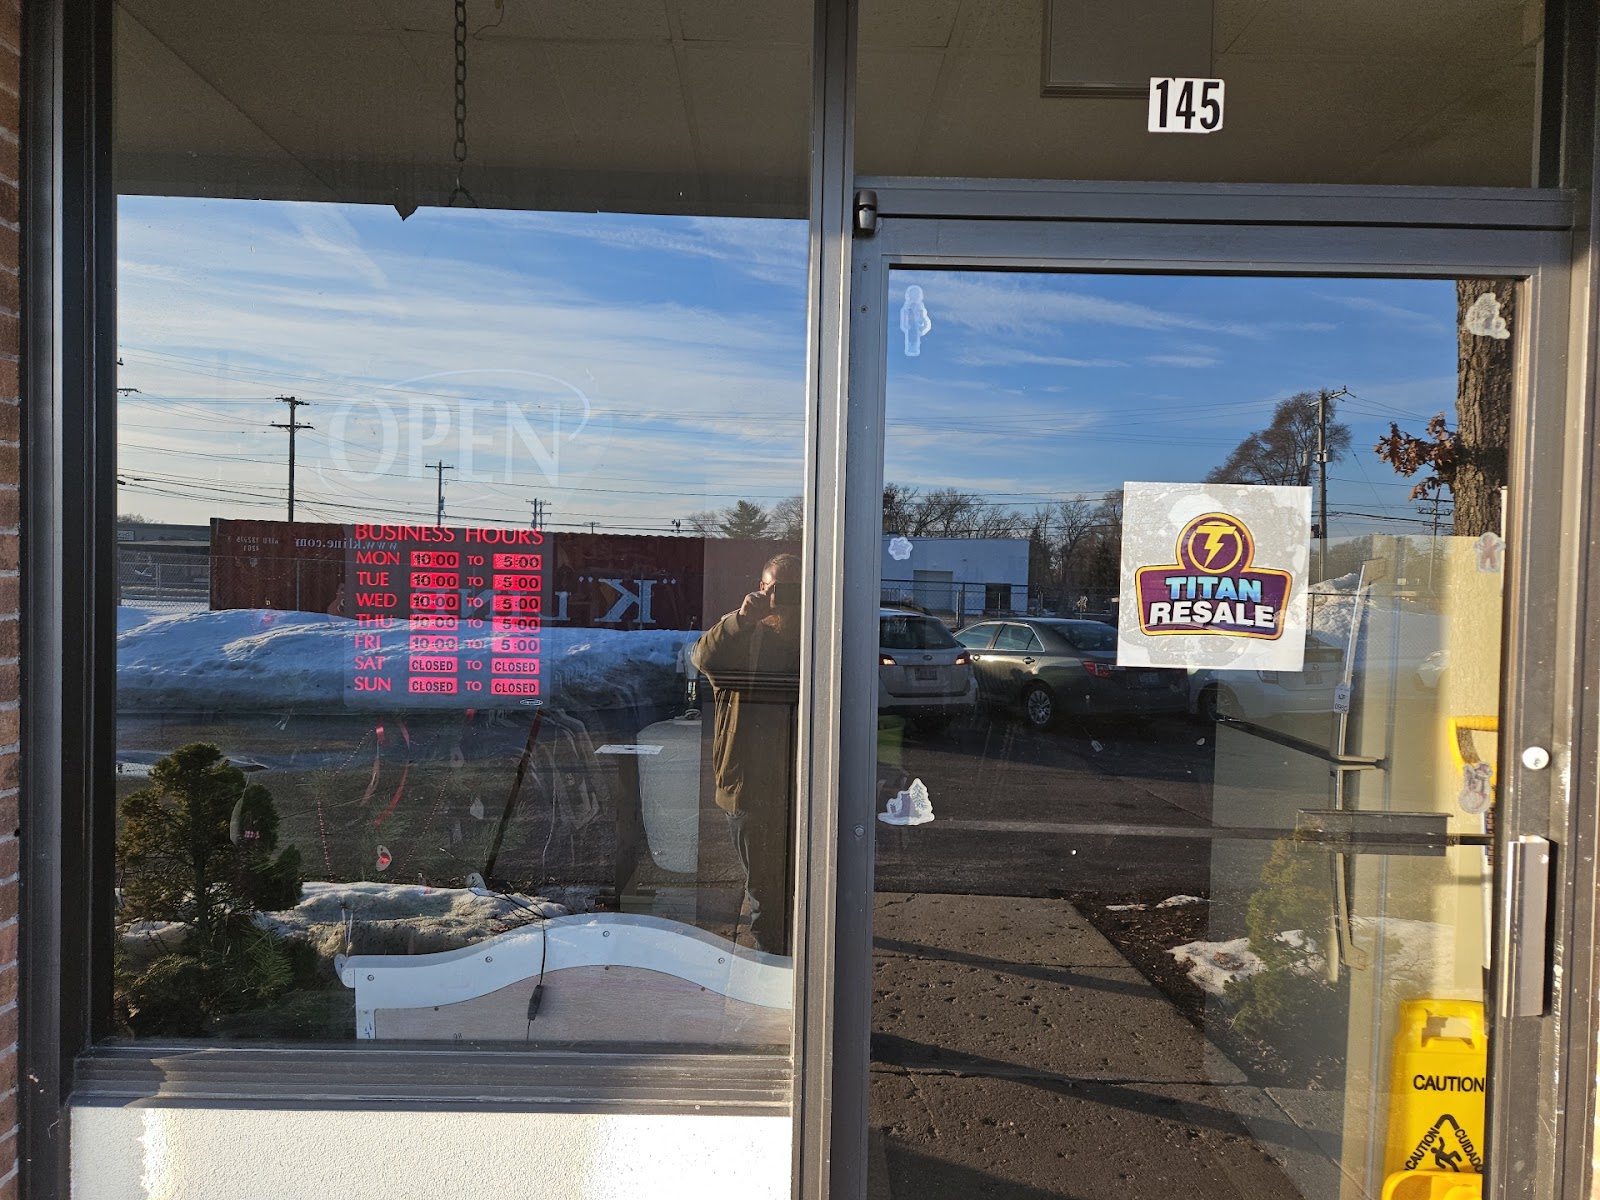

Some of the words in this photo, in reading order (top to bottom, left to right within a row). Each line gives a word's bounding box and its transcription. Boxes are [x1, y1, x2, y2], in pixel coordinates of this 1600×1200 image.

[1156, 80, 1220, 130] 145
[329, 394, 561, 486] OPEN
[354, 524, 456, 542] BUSINESS
[465, 526, 544, 545] HOURS
[356, 551, 400, 566] MON
[413, 554, 457, 566] 10:00
[467, 555, 485, 566] TO
[503, 556, 540, 568] 5:00
[356, 572, 389, 586] TUE
[413, 575, 457, 587] 10:00
[467, 577, 484, 587] TO
[503, 577, 539, 589] 5:00
[1165, 576, 1262, 602] TITAN
[356, 593, 397, 608] WED
[413, 596, 457, 608] 10:00
[467, 598, 484, 608] TO
[502, 598, 539, 610] 5:00
[356, 614, 395, 628] THU
[467, 618, 483, 629] TO
[501, 619, 538, 631] 5:00
[1149, 601, 1275, 628] RESALE
[354, 635, 381, 649] FRI
[466, 639, 483, 649] TO
[501, 640, 537, 651] 5:00
[354, 656, 385, 670] SAT
[412, 660, 453, 671] CLOSED
[466, 660, 483, 670] TO
[494, 661, 536, 672] CLOSED
[354, 677, 391, 691] SUN
[412, 681, 453, 692] CLOSED
[466, 681, 482, 691] TO
[494, 682, 536, 693] CLOSED
[1413, 1074, 1485, 1092] CAUTION
[1405, 1126, 1440, 1170] CAUTION
